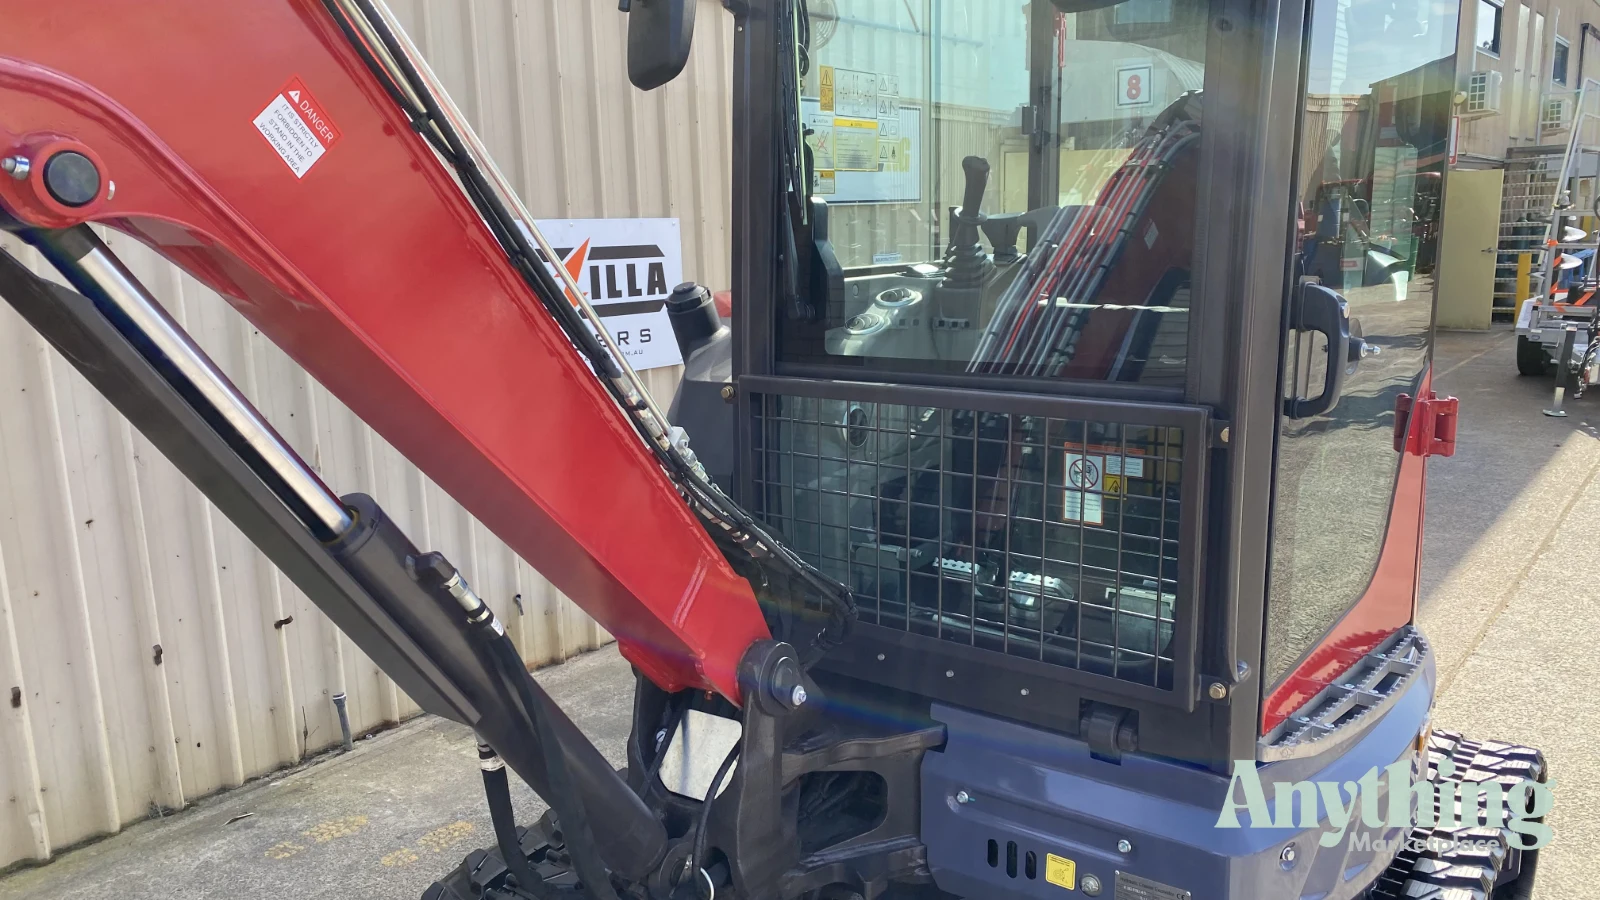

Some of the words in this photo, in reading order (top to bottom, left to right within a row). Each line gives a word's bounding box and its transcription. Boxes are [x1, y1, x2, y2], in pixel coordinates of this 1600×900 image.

[1126, 74, 1142, 101] 8
[268, 118, 288, 142] STAND
[286, 140, 295, 150] IN
[293, 147, 306, 163] THE
[273, 109, 306, 149] FORBIDDEN
[304, 146, 313, 158] TO
[281, 103, 290, 112] IT
[287, 110, 296, 120] IS
[293, 118, 319, 149] STRICTLY
[299, 99, 335, 144] DANGER
[258, 122, 287, 156] WORKING
[285, 154, 301, 173] AREA
